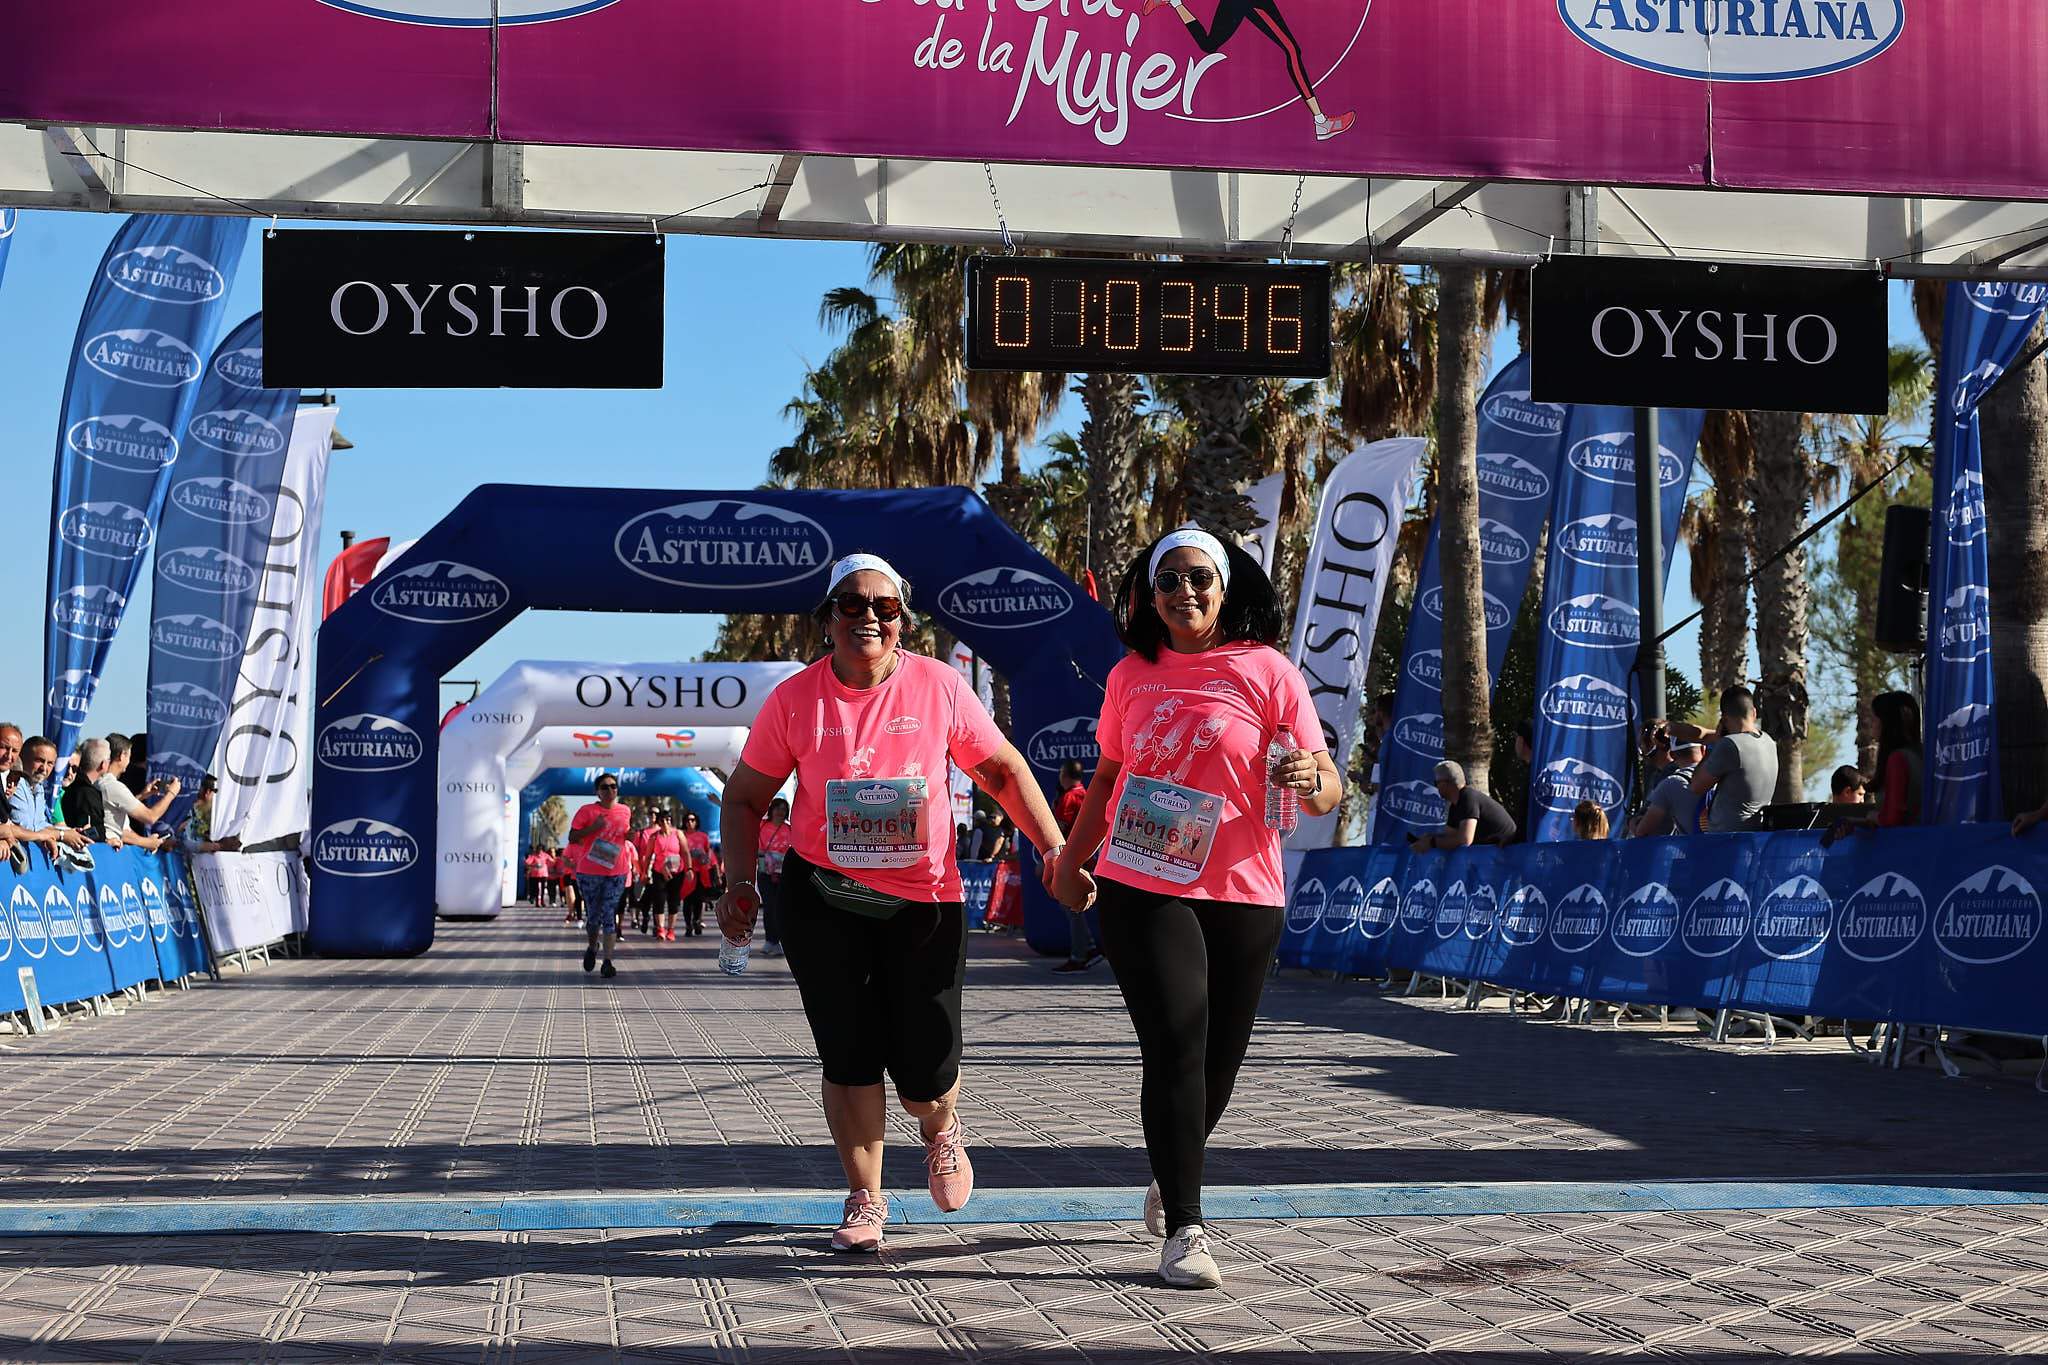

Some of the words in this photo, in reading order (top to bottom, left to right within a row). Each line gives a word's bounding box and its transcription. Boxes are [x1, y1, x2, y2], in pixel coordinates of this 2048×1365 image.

[1585, 0, 1878, 42] ASTURIANA
[914, 13, 966, 70] de
[977, 14, 1014, 73] la
[1006, 15, 1228, 146] Mujer
[116, 259, 214, 297] ASTURIANA
[331, 280, 608, 340] OYSHO
[1590, 305, 1838, 365] OYSHO
[92, 343, 191, 377] ASTURIANA
[1488, 399, 1561, 431] ASTURIANA
[195, 419, 276, 450] ASTURIANA
[1478, 469, 1541, 494] STURIANA
[178, 486, 262, 518] ASTURIANA
[665, 525, 734, 536] CENTRAL
[741, 526, 810, 537] LECHERA
[631, 526, 818, 567] ASTURIANA
[164, 557, 248, 588] ASTURIANA
[379, 584, 500, 608] ASTURIANA
[950, 592, 1065, 614] ASTURIANA
[152, 624, 234, 655] ASTURIANA
[224, 486, 304, 788] OYSHO
[1556, 610, 1640, 640] ASTURIANA
[576, 674, 748, 709] OYSHO
[1130, 684, 1166, 696] OYSHO
[471, 713, 523, 725] OYSHO
[813, 726, 852, 737] OYSHO
[321, 735, 415, 759] ASTURIANA
[1034, 739, 1100, 761] ASTURI
[447, 782, 496, 794] OYSHO
[858, 791, 896, 801] ASTURIANA
[1151, 793, 1188, 810] ASTURIANA
[317, 839, 411, 862] ASTURIANA
[444, 852, 493, 865] OYSHO
[1115, 839, 1137, 851] CARRERA
[1144, 848, 1151, 856] LA
[1151, 849, 1170, 862] MUJER
[1173, 857, 1197, 870] VALENCIA
[1117, 851, 1144, 867] OYSHO
[1553, 909, 1601, 934] ASTURIANA
[1615, 910, 1672, 937] ASTURIANA
[1685, 908, 1744, 937] ASTURIANA
[1758, 907, 1825, 937] ASTURIANA
[1842, 905, 1917, 938] ASTURIANA
[1939, 902, 2031, 938] ASTURIANA
